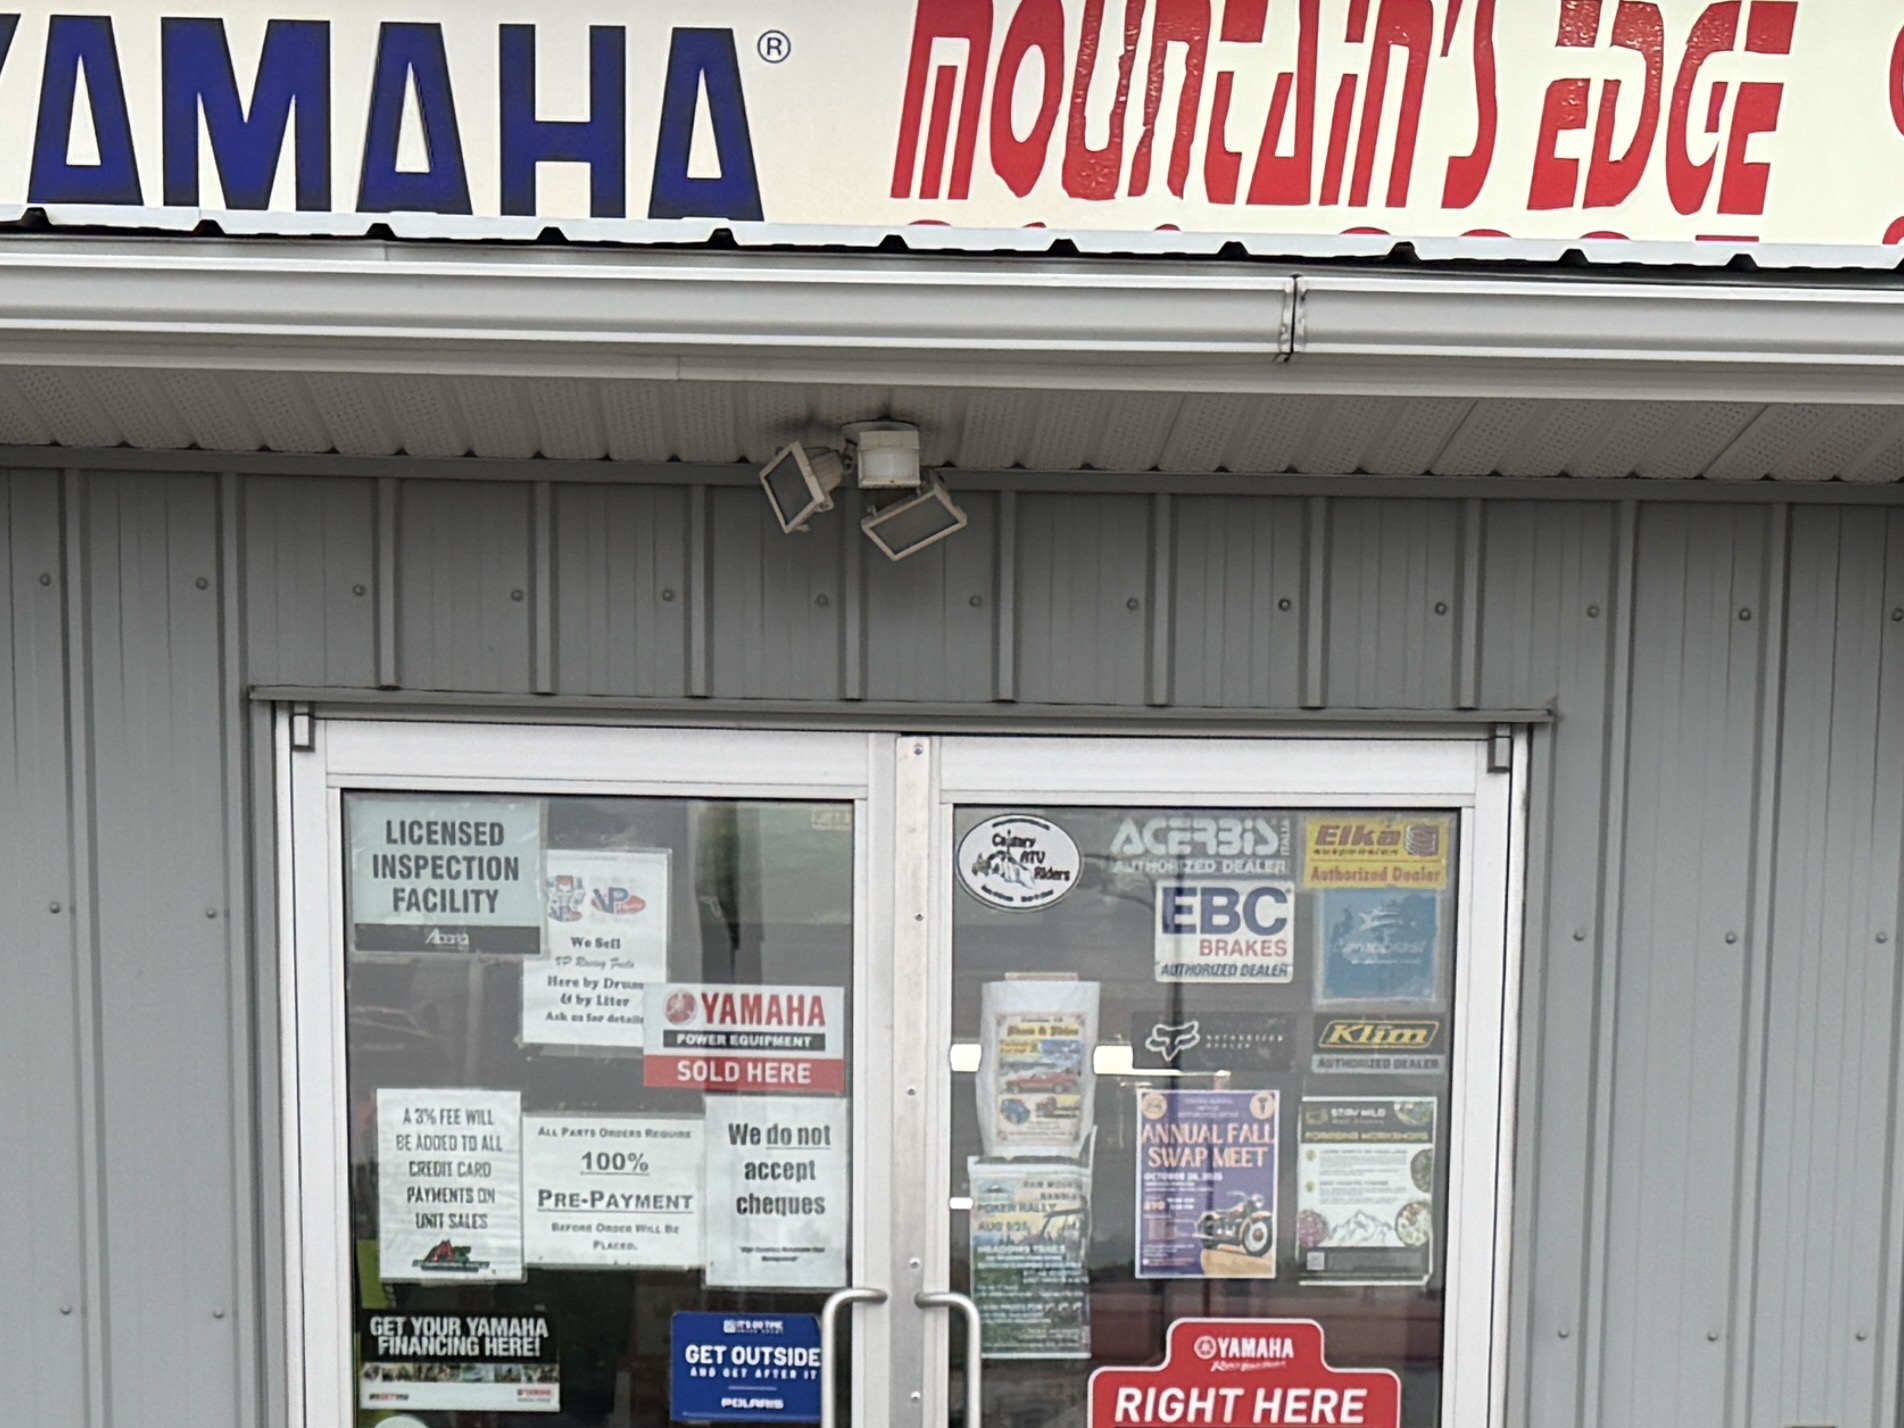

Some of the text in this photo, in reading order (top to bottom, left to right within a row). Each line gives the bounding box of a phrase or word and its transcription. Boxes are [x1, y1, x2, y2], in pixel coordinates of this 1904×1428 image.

[1527, 0, 1796, 215] EDGE
[386, 820, 505, 846] LICENSED
[1110, 817, 1279, 856] ACERBIS
[1315, 825, 1402, 846] Elka
[373, 854, 519, 881] INSPECTION
[1222, 858, 1286, 874] DEALER
[1311, 866, 1440, 882] Authorized Dealer
[392, 888, 499, 914] FACILITY
[1162, 886, 1288, 937] EBC
[571, 937, 592, 948] We
[1199, 939, 1288, 957] BRAKES
[1161, 963, 1288, 977] AUTHORIZED DEALER
[701, 993, 826, 1026] YAMAHA
[676, 1033, 812, 1048] POWER EQUIPMENT
[677, 1060, 811, 1084] SOLD HERE
[1393, 1059, 1439, 1069] DEALER
[402, 1108, 495, 1126] A 3% FEE WILL
[396, 1134, 503, 1152] BE ADDED TO ALL
[728, 1123, 831, 1146] We do not
[1142, 1123, 1274, 1144] ANNUAL FALL
[581, 1151, 649, 1173] 100%
[1148, 1148, 1268, 1168] SWAP MEET
[409, 1161, 491, 1178] CREDIT CARD
[744, 1160, 816, 1182] accept
[407, 1187, 495, 1204] PAYMENTS ON
[736, 1192, 826, 1216] cheques
[416, 1213, 488, 1229] UNIT SALES
[370, 1316, 549, 1338] GET YOUR YAMAHA
[378, 1336, 541, 1357] FINANCING HERE!
[685, 1344, 821, 1367] GET OUTSIDE
[1217, 1337, 1294, 1358] YAMAHA
[690, 1367, 817, 1380] AND GET AFTER IT
[721, 1398, 784, 1409] POLARIS
[1114, 1387, 1368, 1424] RIGHT HERE
